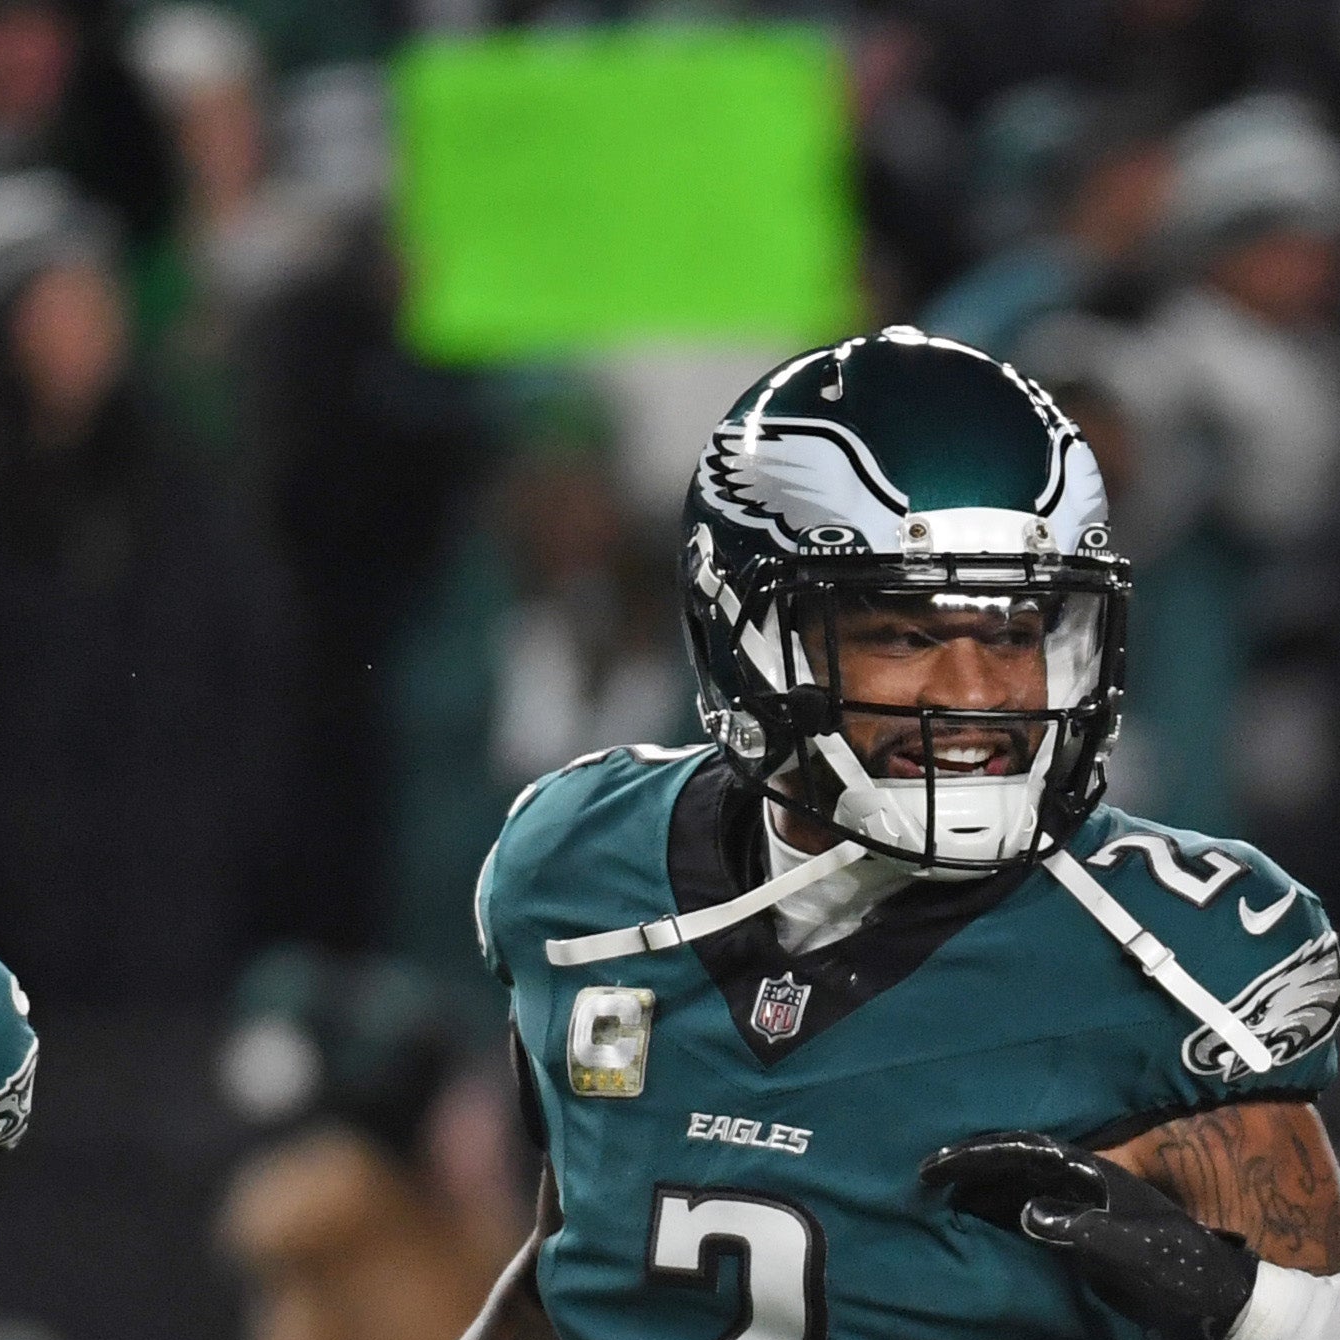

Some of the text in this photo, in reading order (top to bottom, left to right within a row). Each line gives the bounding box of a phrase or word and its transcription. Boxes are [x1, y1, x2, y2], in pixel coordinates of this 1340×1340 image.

[798, 545, 870, 557] OAKLEY
[1084, 831, 1251, 909] 2
[573, 993, 643, 1069] C
[686, 1112, 814, 1154] EAGLES
